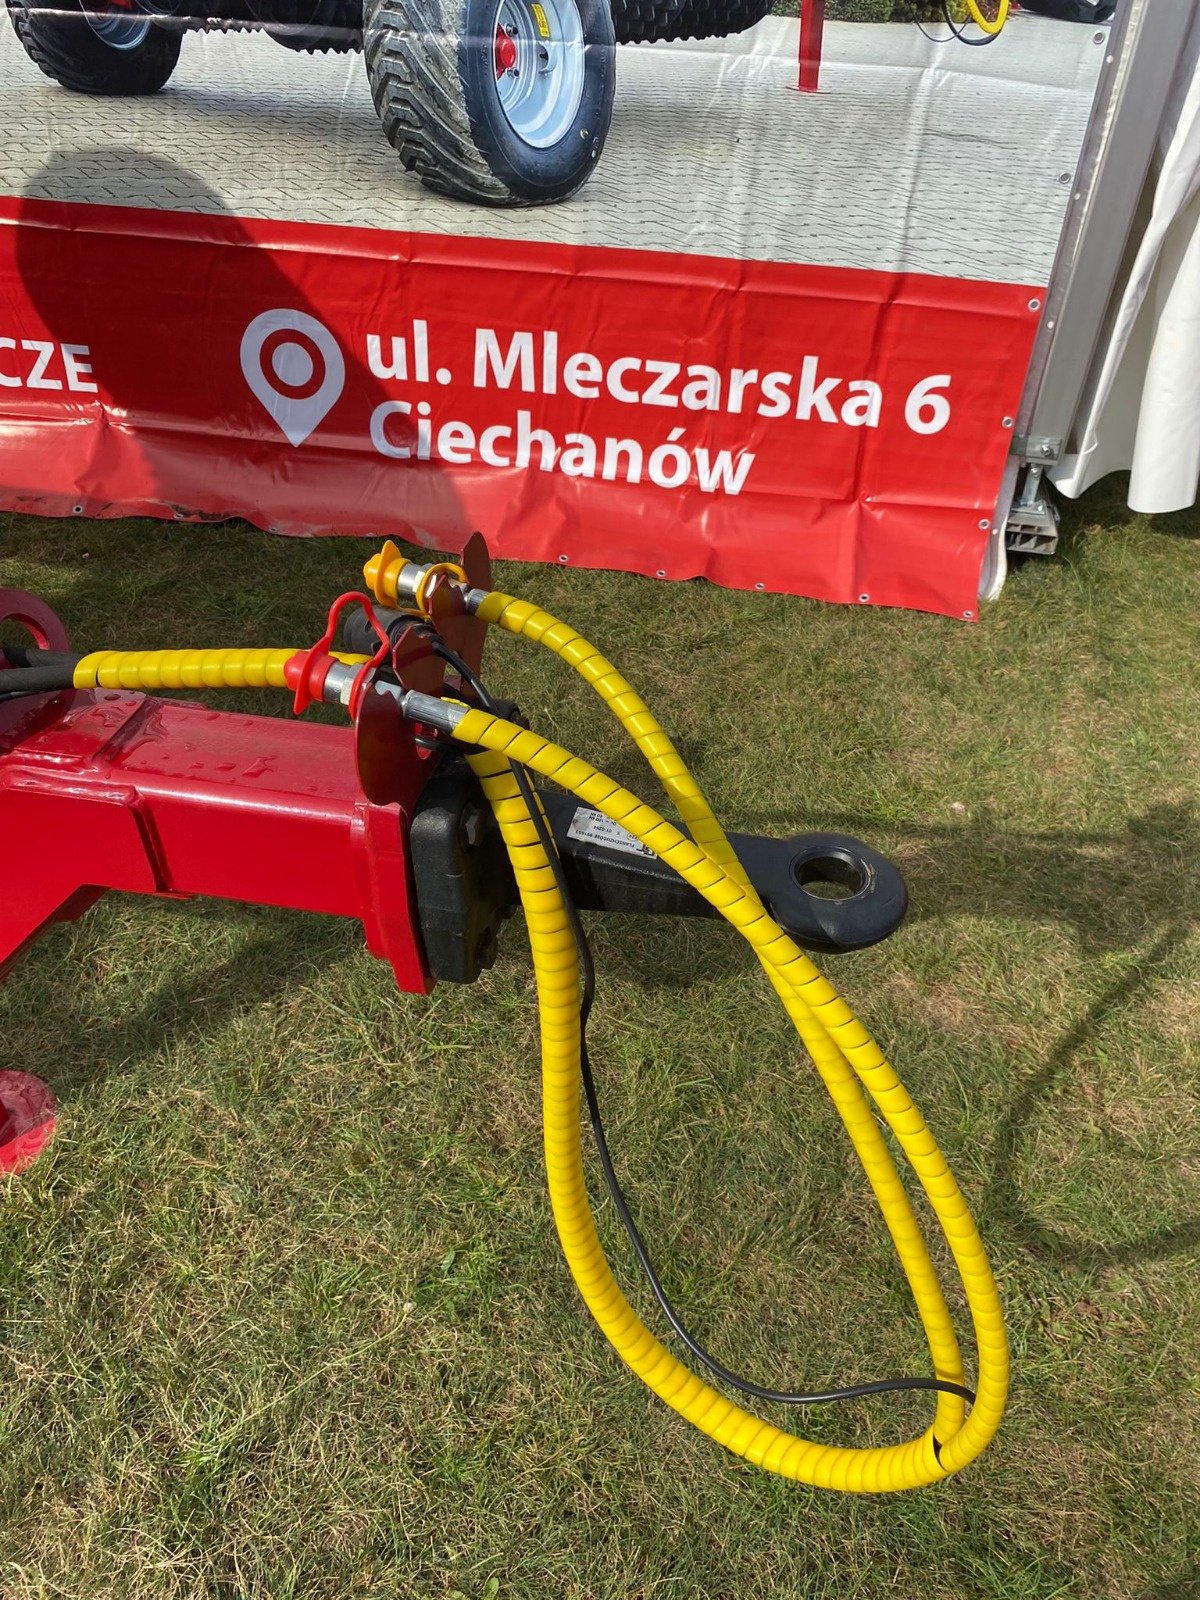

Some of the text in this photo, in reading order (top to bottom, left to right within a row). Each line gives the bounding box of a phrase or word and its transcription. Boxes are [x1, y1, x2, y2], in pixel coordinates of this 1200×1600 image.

[366, 319, 951, 435] ul. Mleczarska 6
[369, 400, 755, 495] Ciechanów
